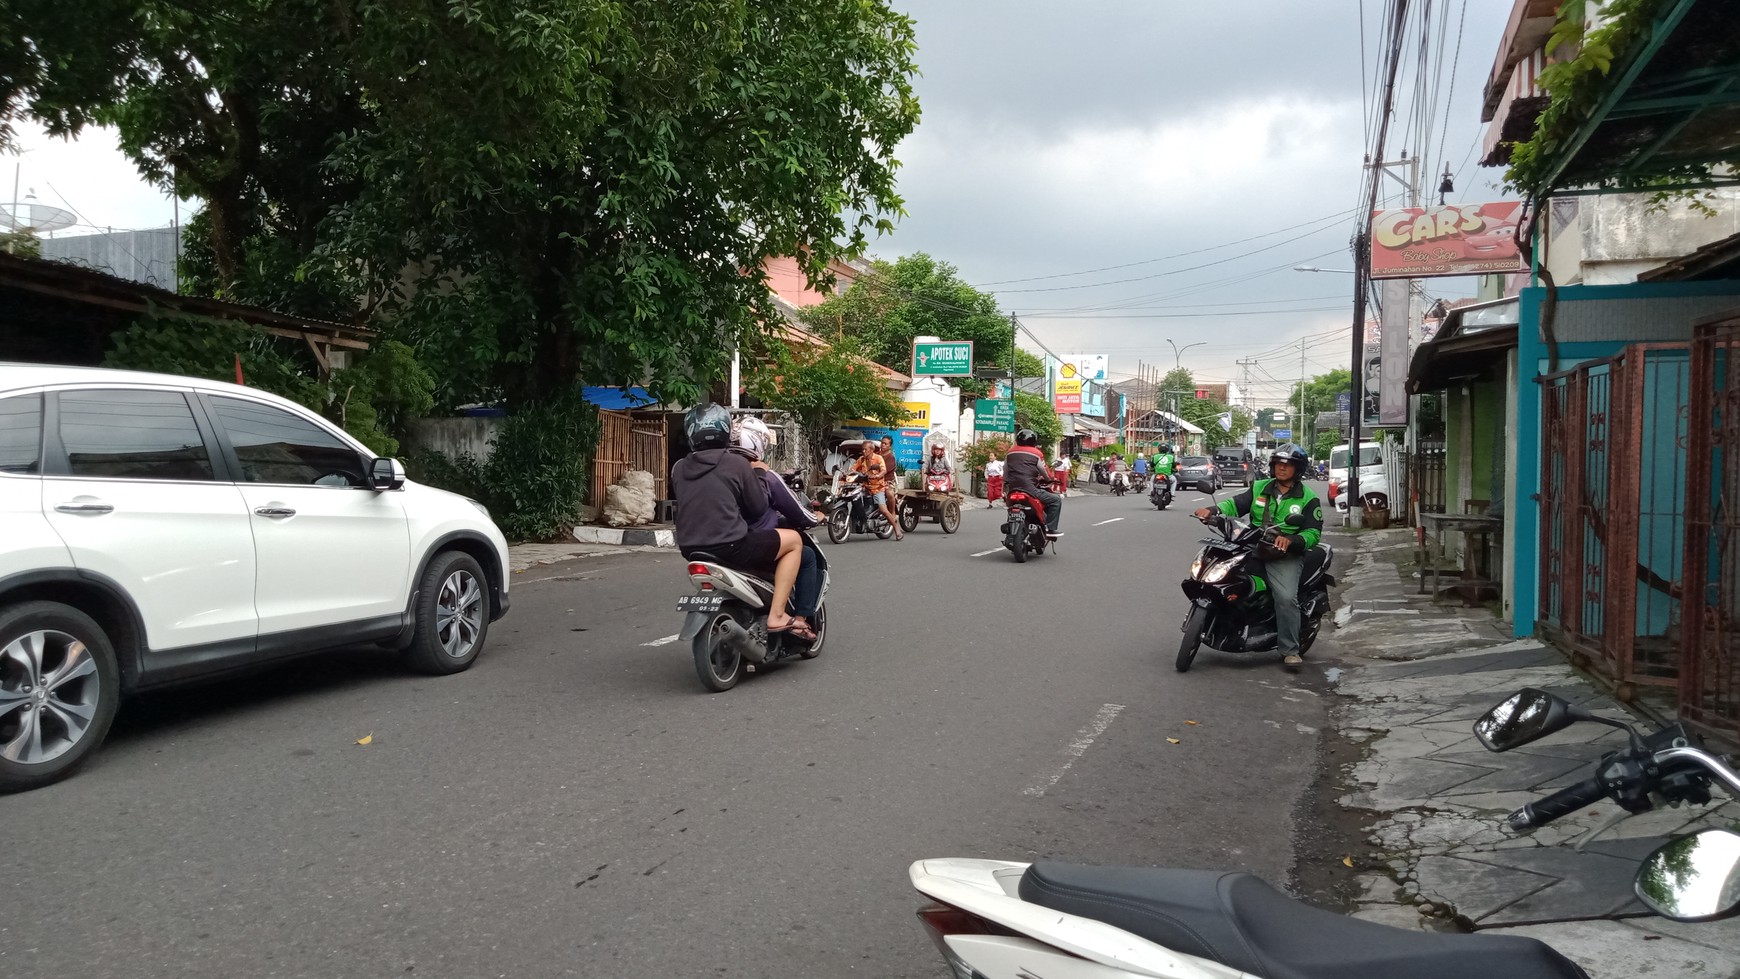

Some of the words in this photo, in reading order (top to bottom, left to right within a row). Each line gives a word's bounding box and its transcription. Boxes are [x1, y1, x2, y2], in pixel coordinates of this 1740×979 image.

[1375, 205, 1483, 247] CARS
[1401, 249, 1430, 263] Baby
[1431, 248, 1457, 262] Shop
[1382, 265, 1420, 273] Juminahan
[931, 346, 953, 361] APOTEK
[954, 346, 969, 361] SUCI
[678, 596, 689, 604] AB
[690, 596, 709, 604] 6949
[711, 596, 723, 604] MG
